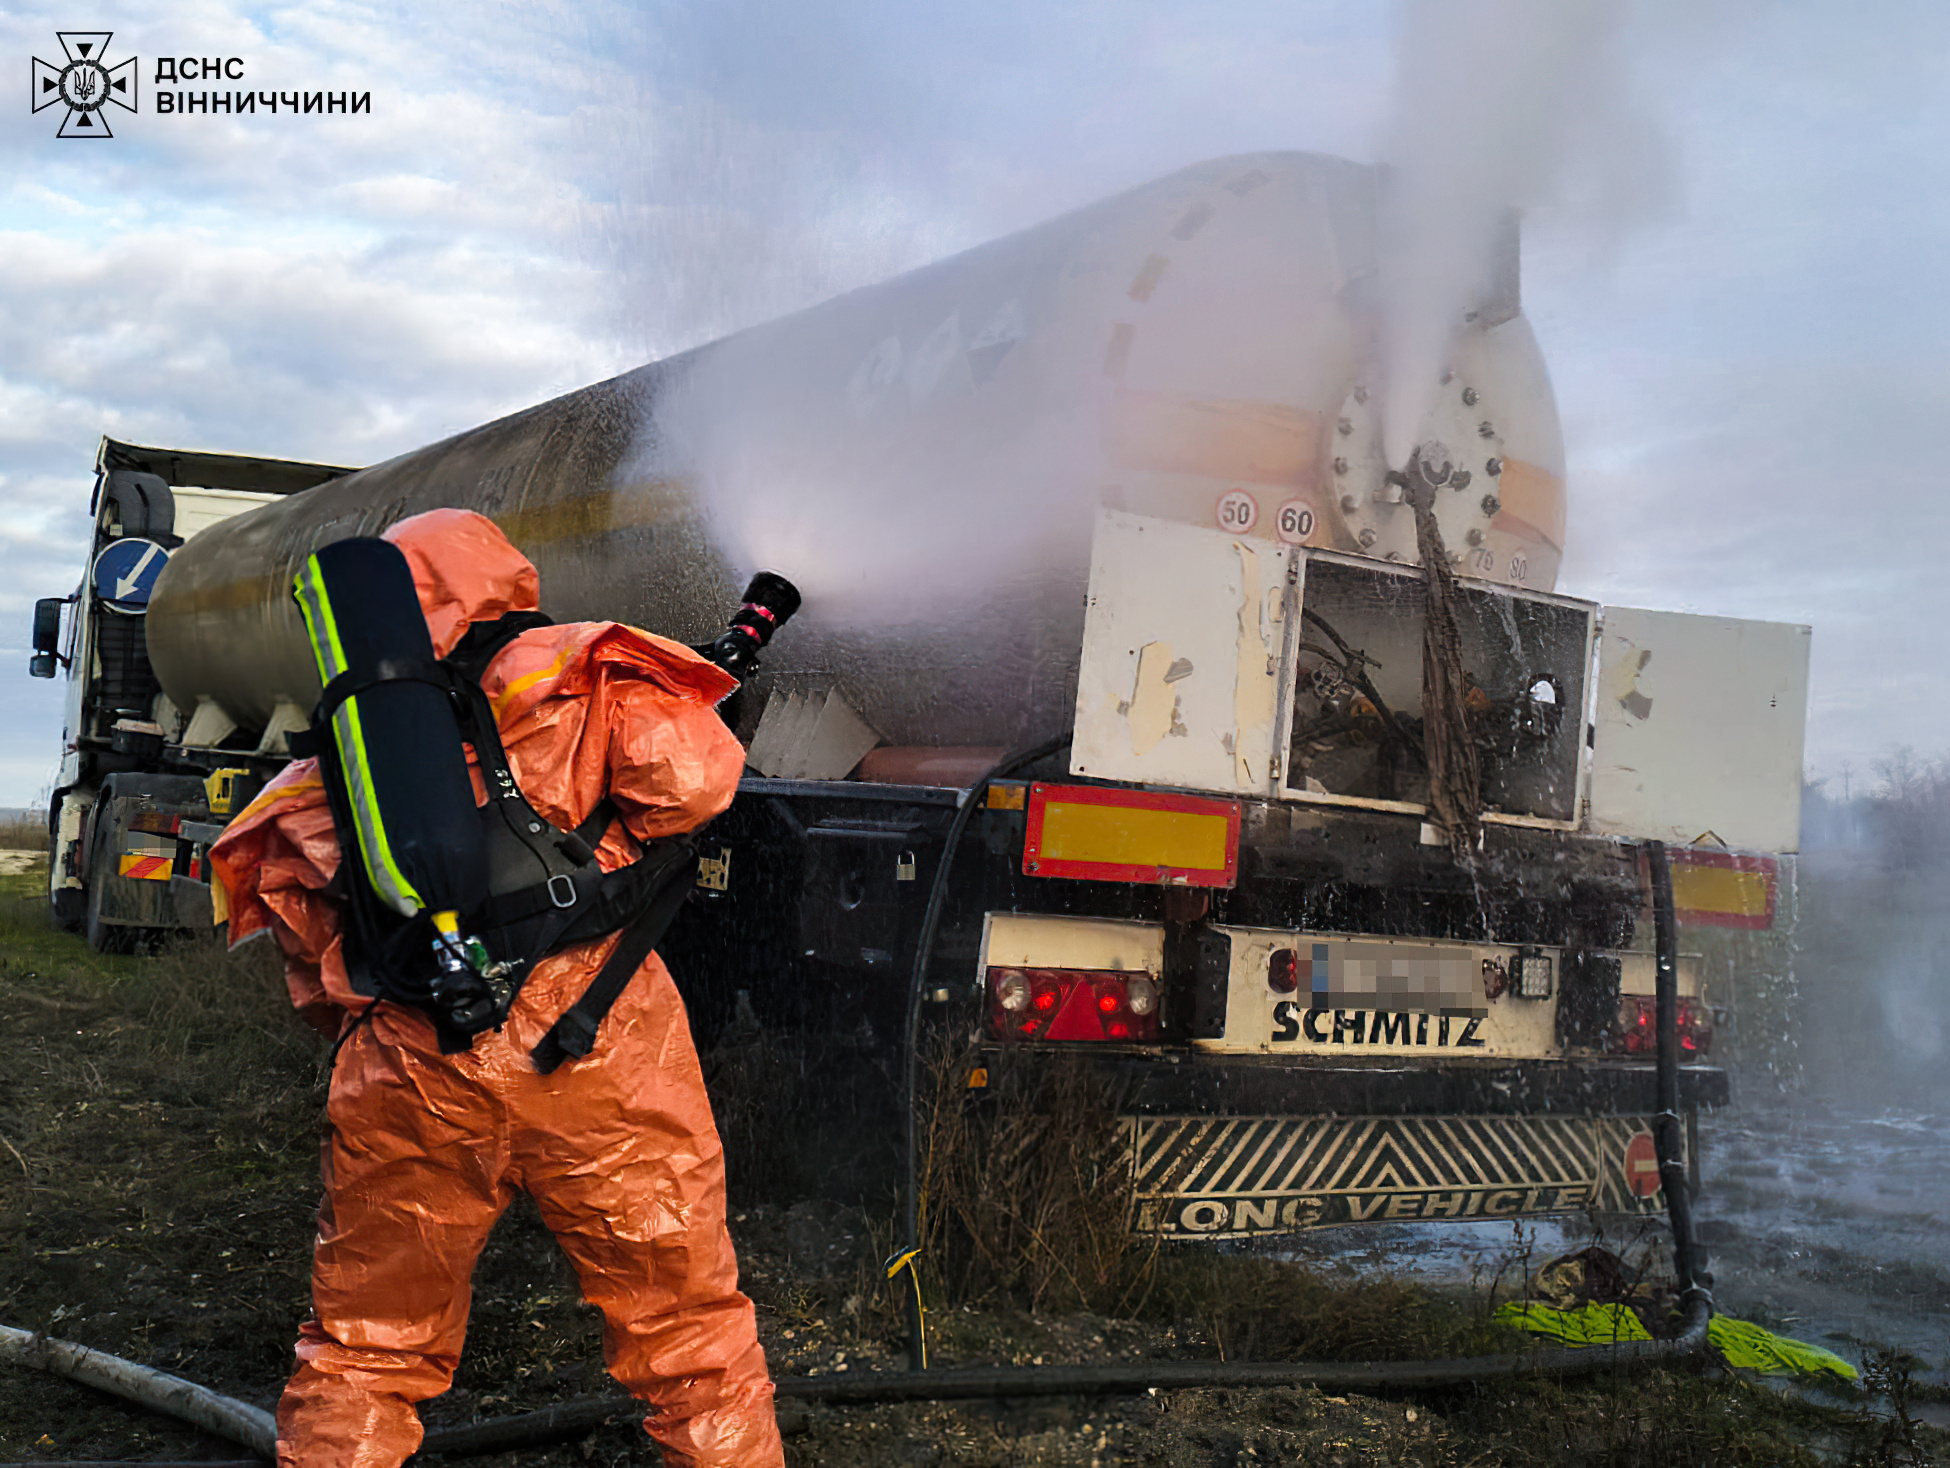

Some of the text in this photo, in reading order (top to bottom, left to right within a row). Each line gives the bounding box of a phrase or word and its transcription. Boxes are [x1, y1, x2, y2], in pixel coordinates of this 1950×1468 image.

[1223, 500, 1250, 525] 50
[1281, 507, 1313, 536] 60
[1136, 1187, 1588, 1232] LONG VEHICLE
